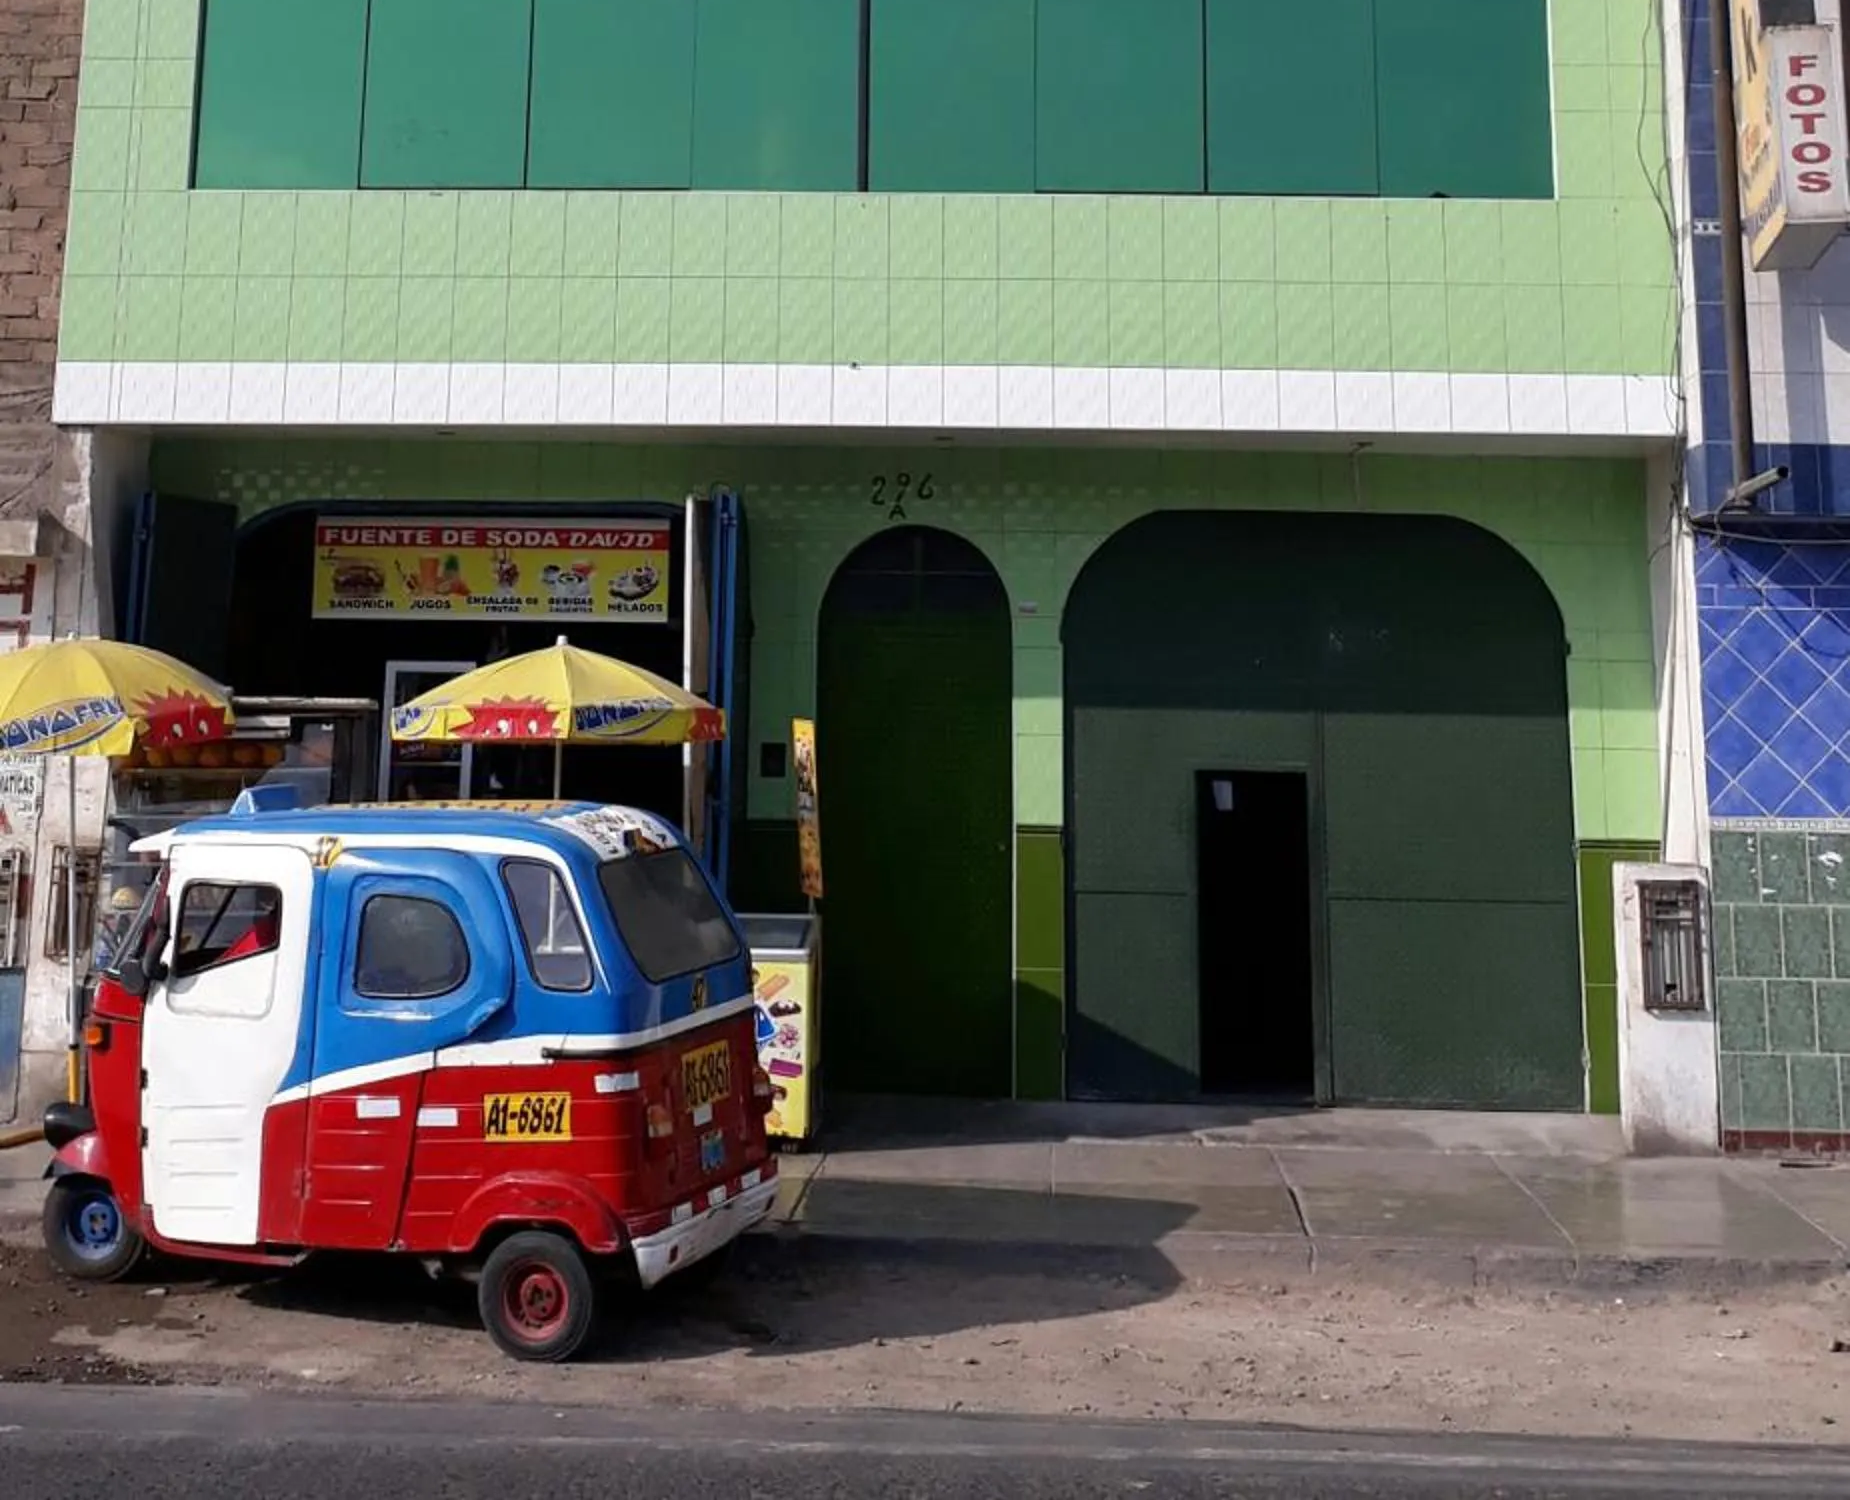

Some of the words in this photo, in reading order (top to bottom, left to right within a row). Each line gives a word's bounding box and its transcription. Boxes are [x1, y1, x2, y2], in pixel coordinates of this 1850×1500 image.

[1786, 54, 1832, 193] FOTOS
[871, 472, 934, 505] 296
[888, 504, 907, 520] A
[324, 528, 433, 545] FUENTE
[441, 529, 477, 546] DE
[486, 530, 560, 547] SODA
[329, 599, 394, 609] SANDWICH
[410, 599, 451, 609] JUGOS
[607, 603, 663, 612] HELADOS
[486, 1096, 567, 1136] A1-6861
